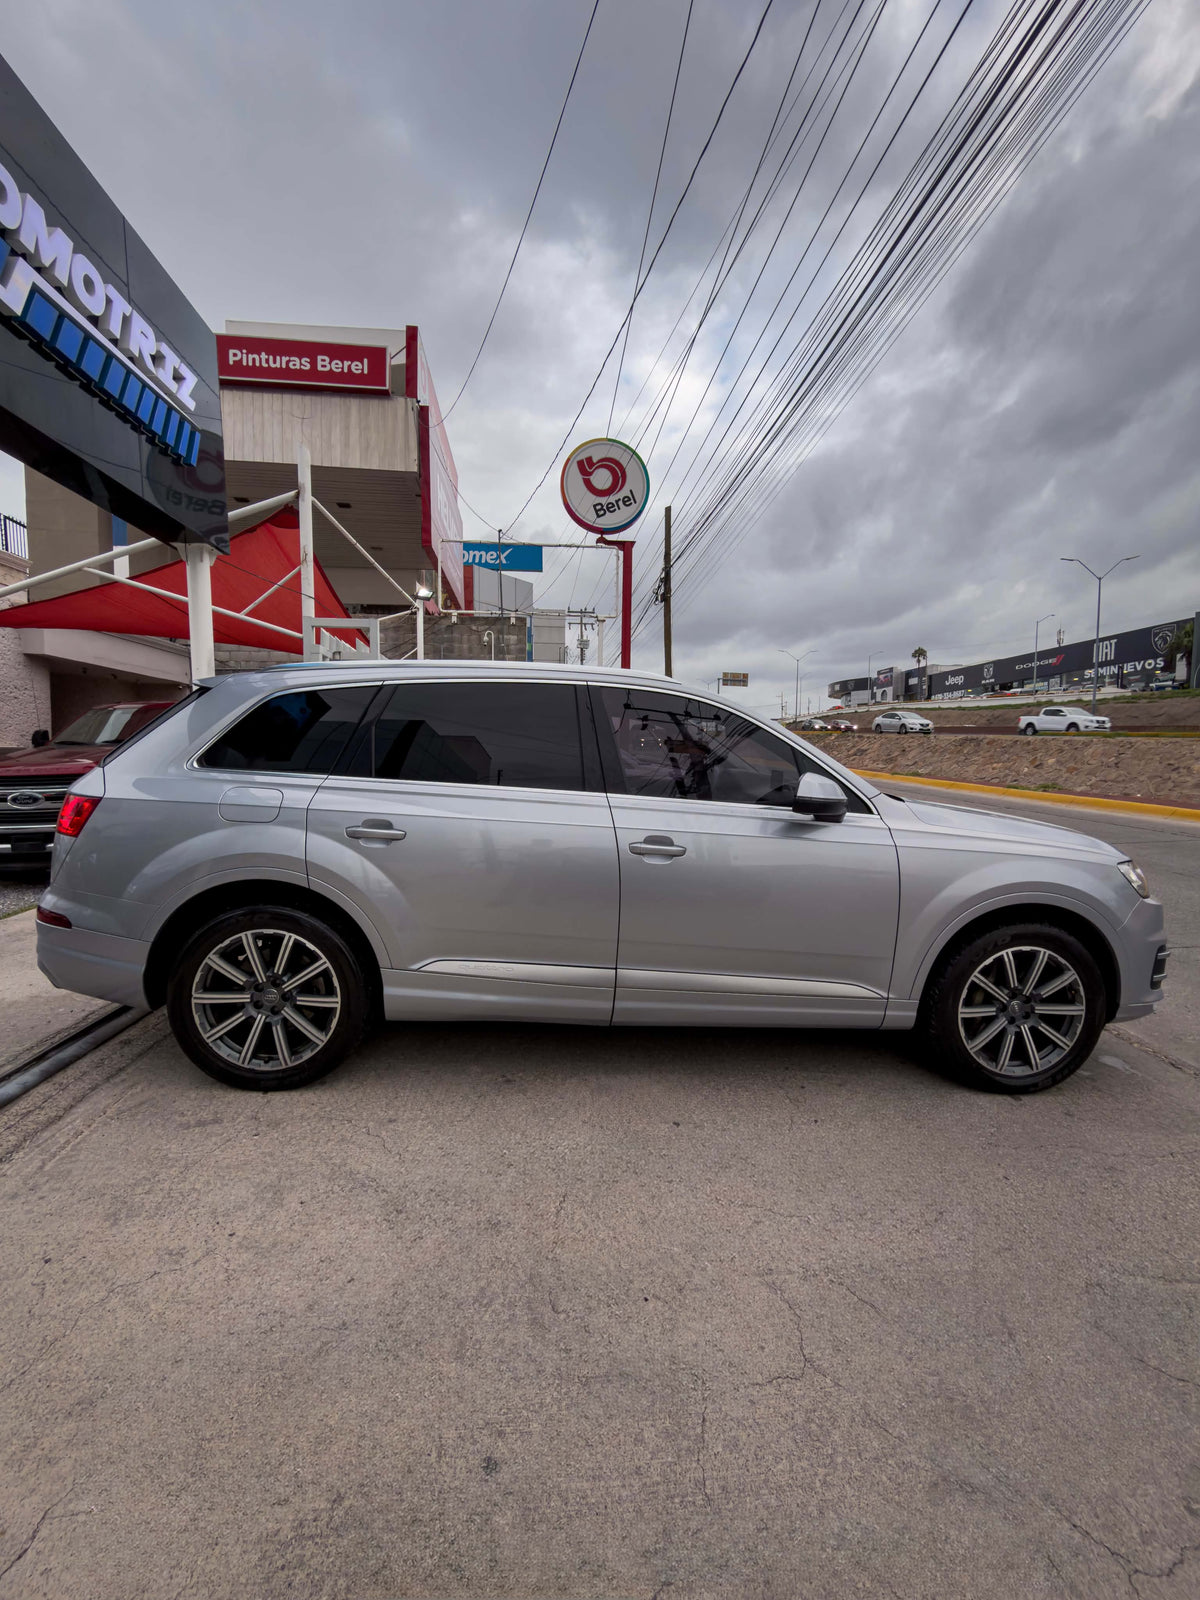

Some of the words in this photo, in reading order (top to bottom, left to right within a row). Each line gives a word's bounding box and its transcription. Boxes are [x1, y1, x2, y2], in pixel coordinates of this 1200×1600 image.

[228, 349, 311, 371] Pinturas
[317, 355, 368, 374] Berel
[592, 489, 637, 518] Berel
[1015, 657, 1057, 670] DODGE
[945, 675, 965, 685] Jeep
